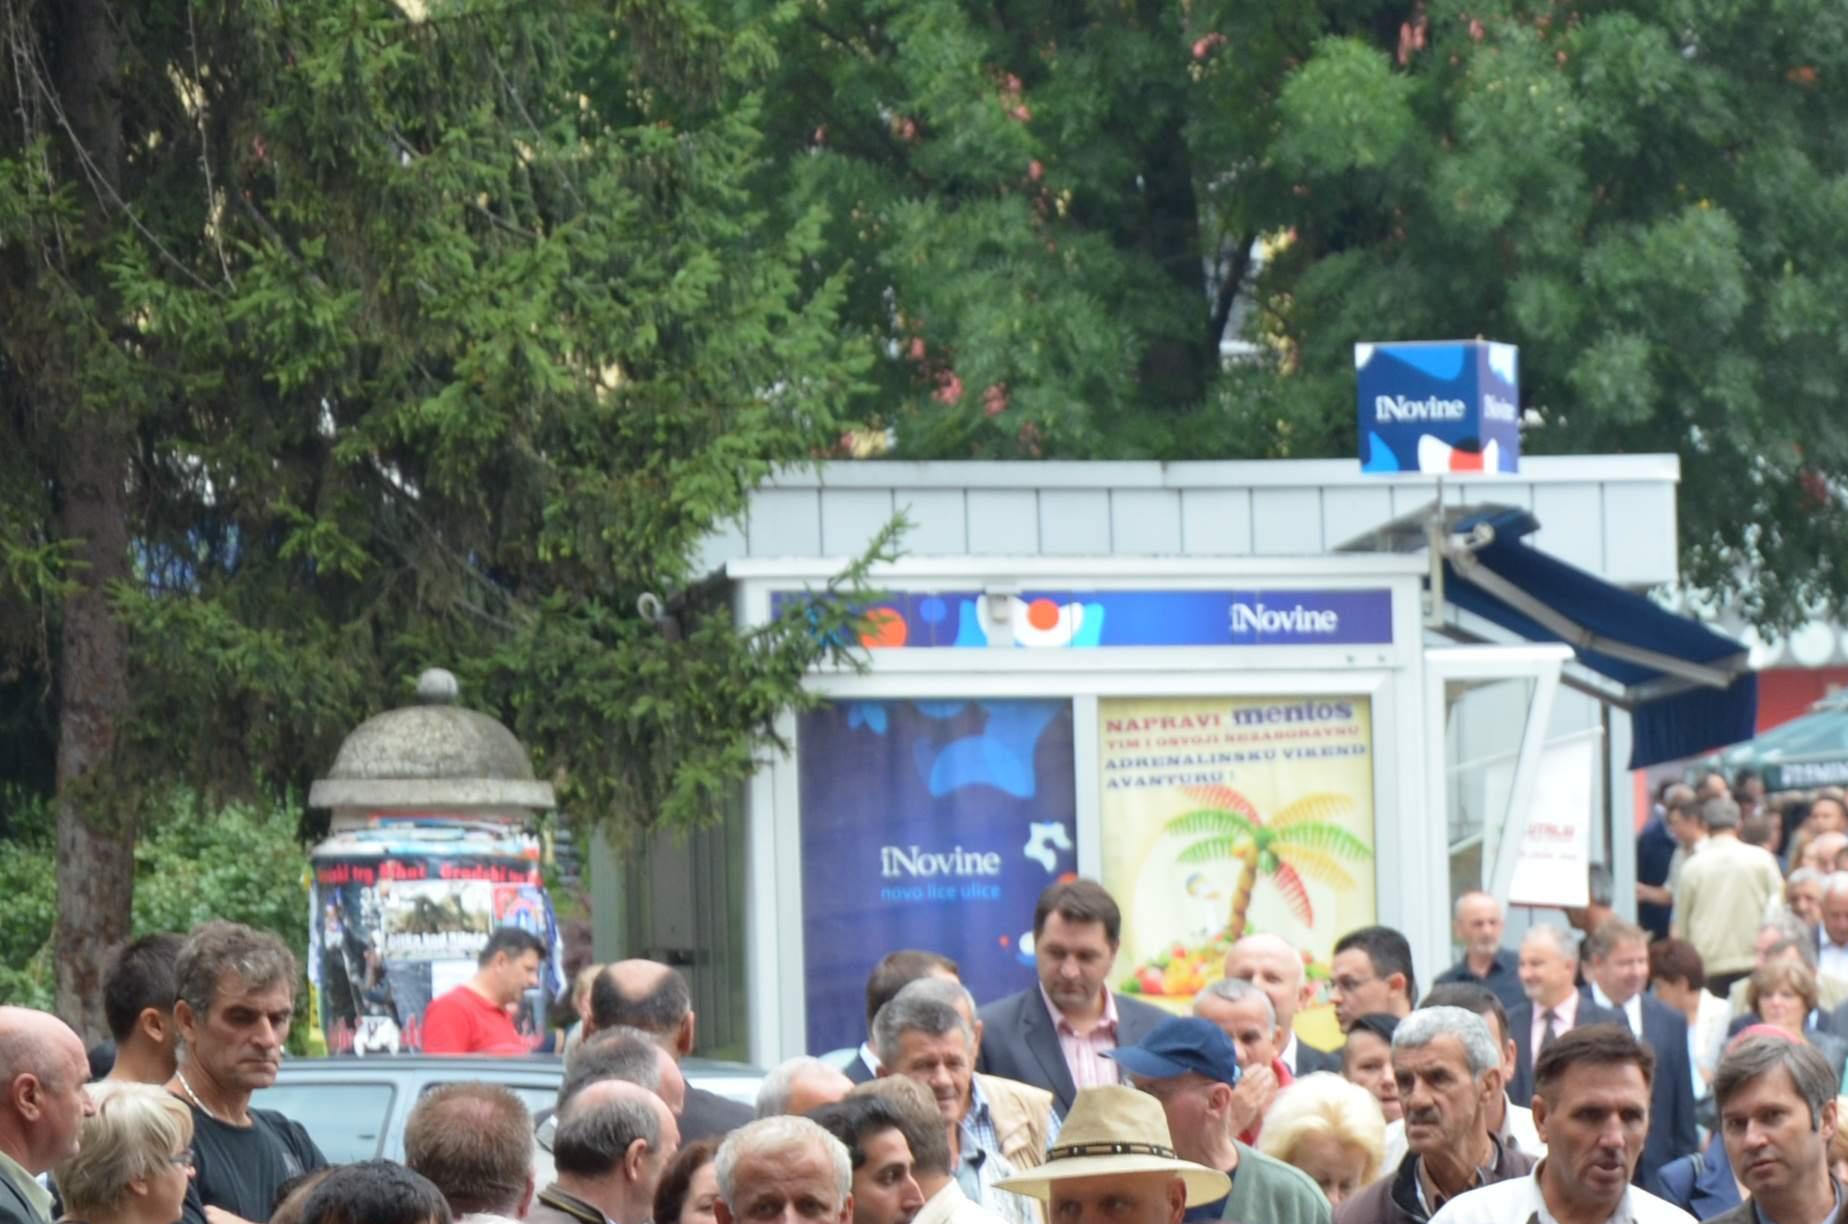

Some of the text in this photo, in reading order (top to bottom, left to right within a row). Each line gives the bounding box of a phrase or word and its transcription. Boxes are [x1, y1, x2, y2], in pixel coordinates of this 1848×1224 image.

[1106, 700, 1353, 733] NAPRAVI mentos
[1107, 737, 1140, 750] TIM
[1105, 743, 1366, 770] ADRENALINSKU VIKEND
[1107, 771, 1224, 790] AVANTURU
[880, 880, 1001, 901] novo lice ulice
